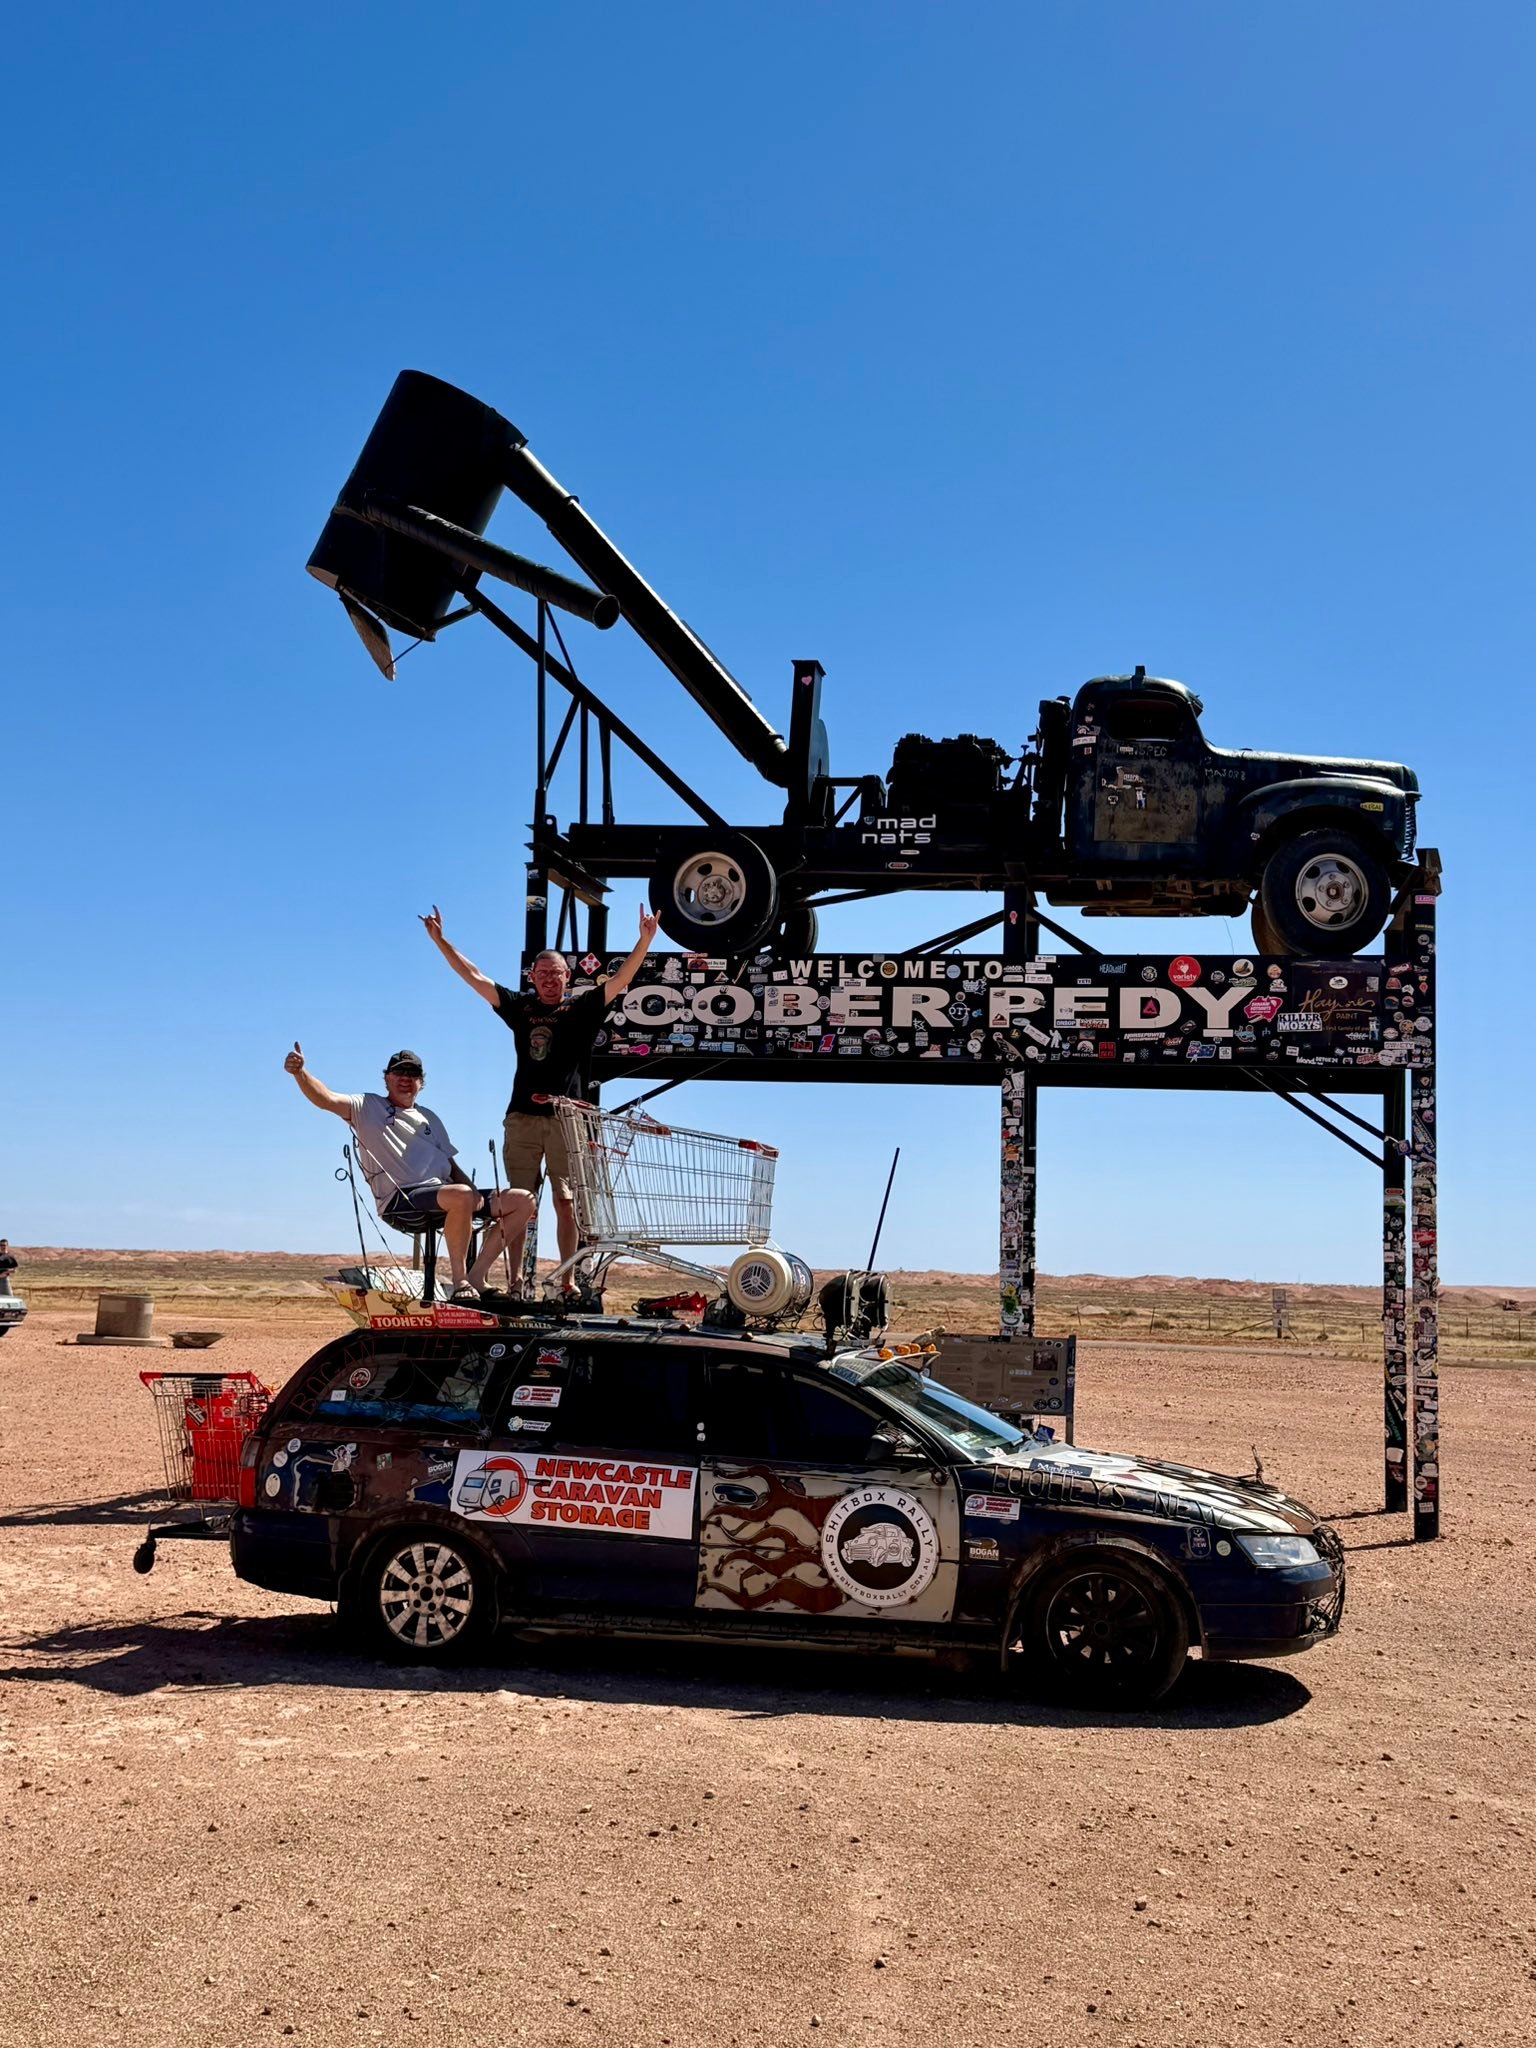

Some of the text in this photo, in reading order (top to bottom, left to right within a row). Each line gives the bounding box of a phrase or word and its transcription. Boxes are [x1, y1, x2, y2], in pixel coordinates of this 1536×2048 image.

[877, 813, 936, 829] mad
[861, 829, 931, 844] nats
[789, 960, 946, 979] WELCOME
[963, 960, 1003, 979] TO
[1172, 973, 1197, 982] variety
[571, 984, 1255, 1029] OOBER PEDY
[1279, 1013, 1321, 1021] KILLER
[1335, 1012, 1358, 1020] PAINT
[1280, 1021, 1321, 1030] MOEYS
[374, 1316, 433, 1328] TOOHEYS
[428, 1461, 453, 1473] BOGAN
[535, 1457, 693, 1490] NEWCASTLE
[533, 1481, 662, 1509] CARAVAN
[530, 1501, 650, 1530] STORAGE
[825, 1492, 933, 1547] SHITBOX RALLY
[969, 1547, 999, 1557] BOGAN
